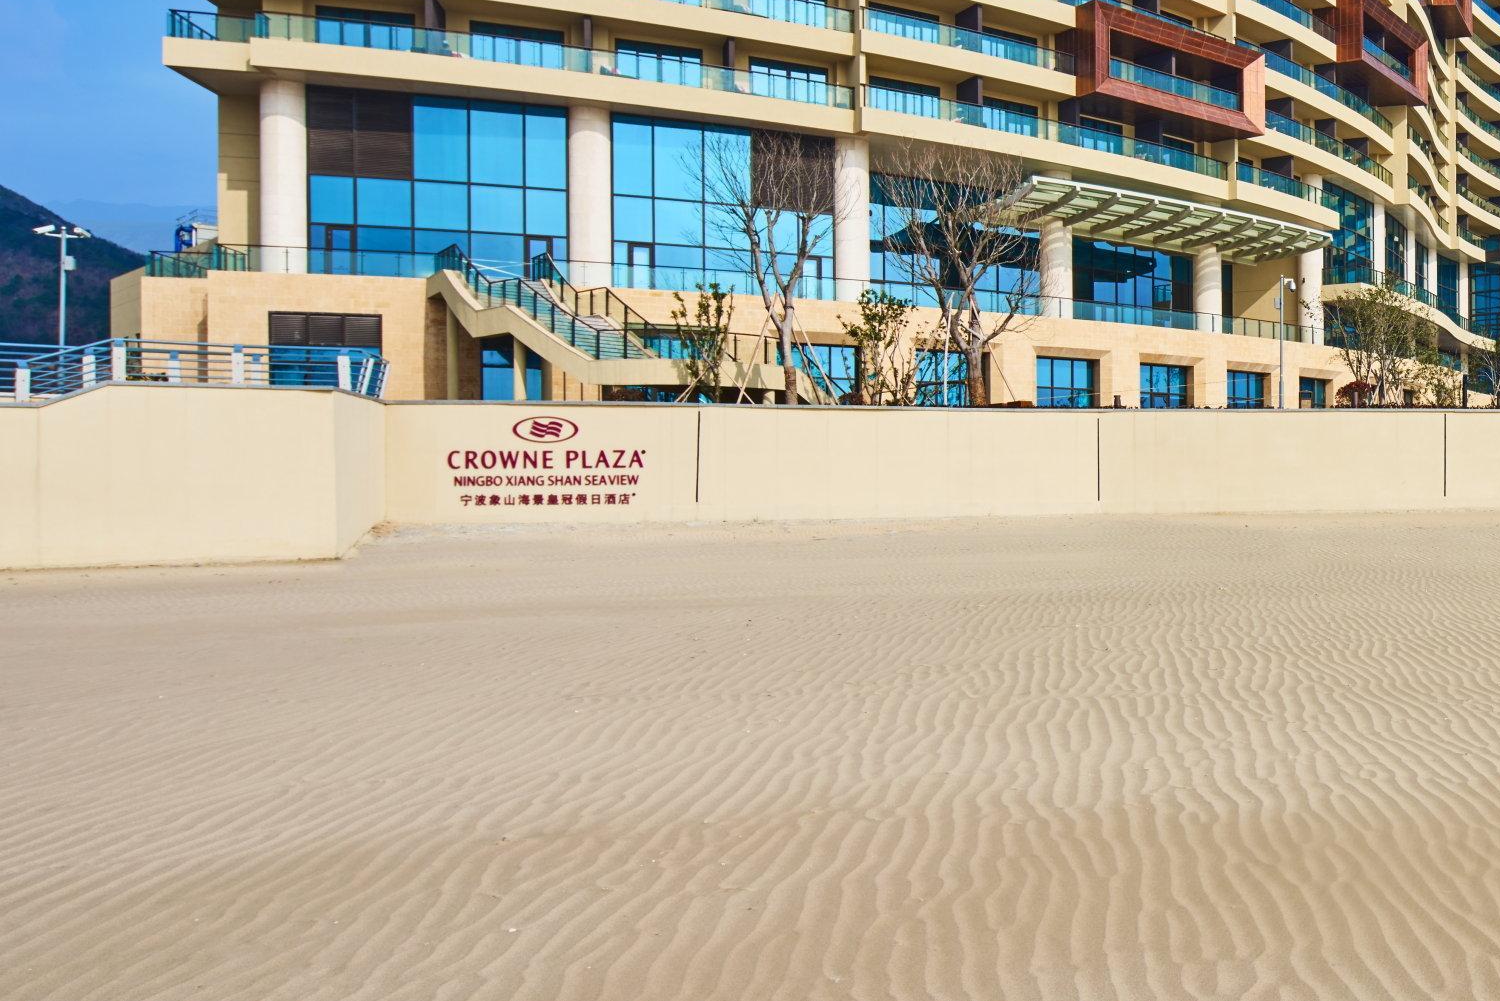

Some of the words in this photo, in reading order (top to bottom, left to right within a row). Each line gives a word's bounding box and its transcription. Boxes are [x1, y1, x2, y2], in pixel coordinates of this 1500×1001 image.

[447, 450, 554, 469] CROWNE
[566, 449, 644, 468] PLAZA
[453, 475, 503, 487] NINGBO
[505, 475, 545, 487] XIANG
[547, 475, 582, 487] SHAN
[459, 493, 631, 506] 宁波象山海景皇冠假日酒店
